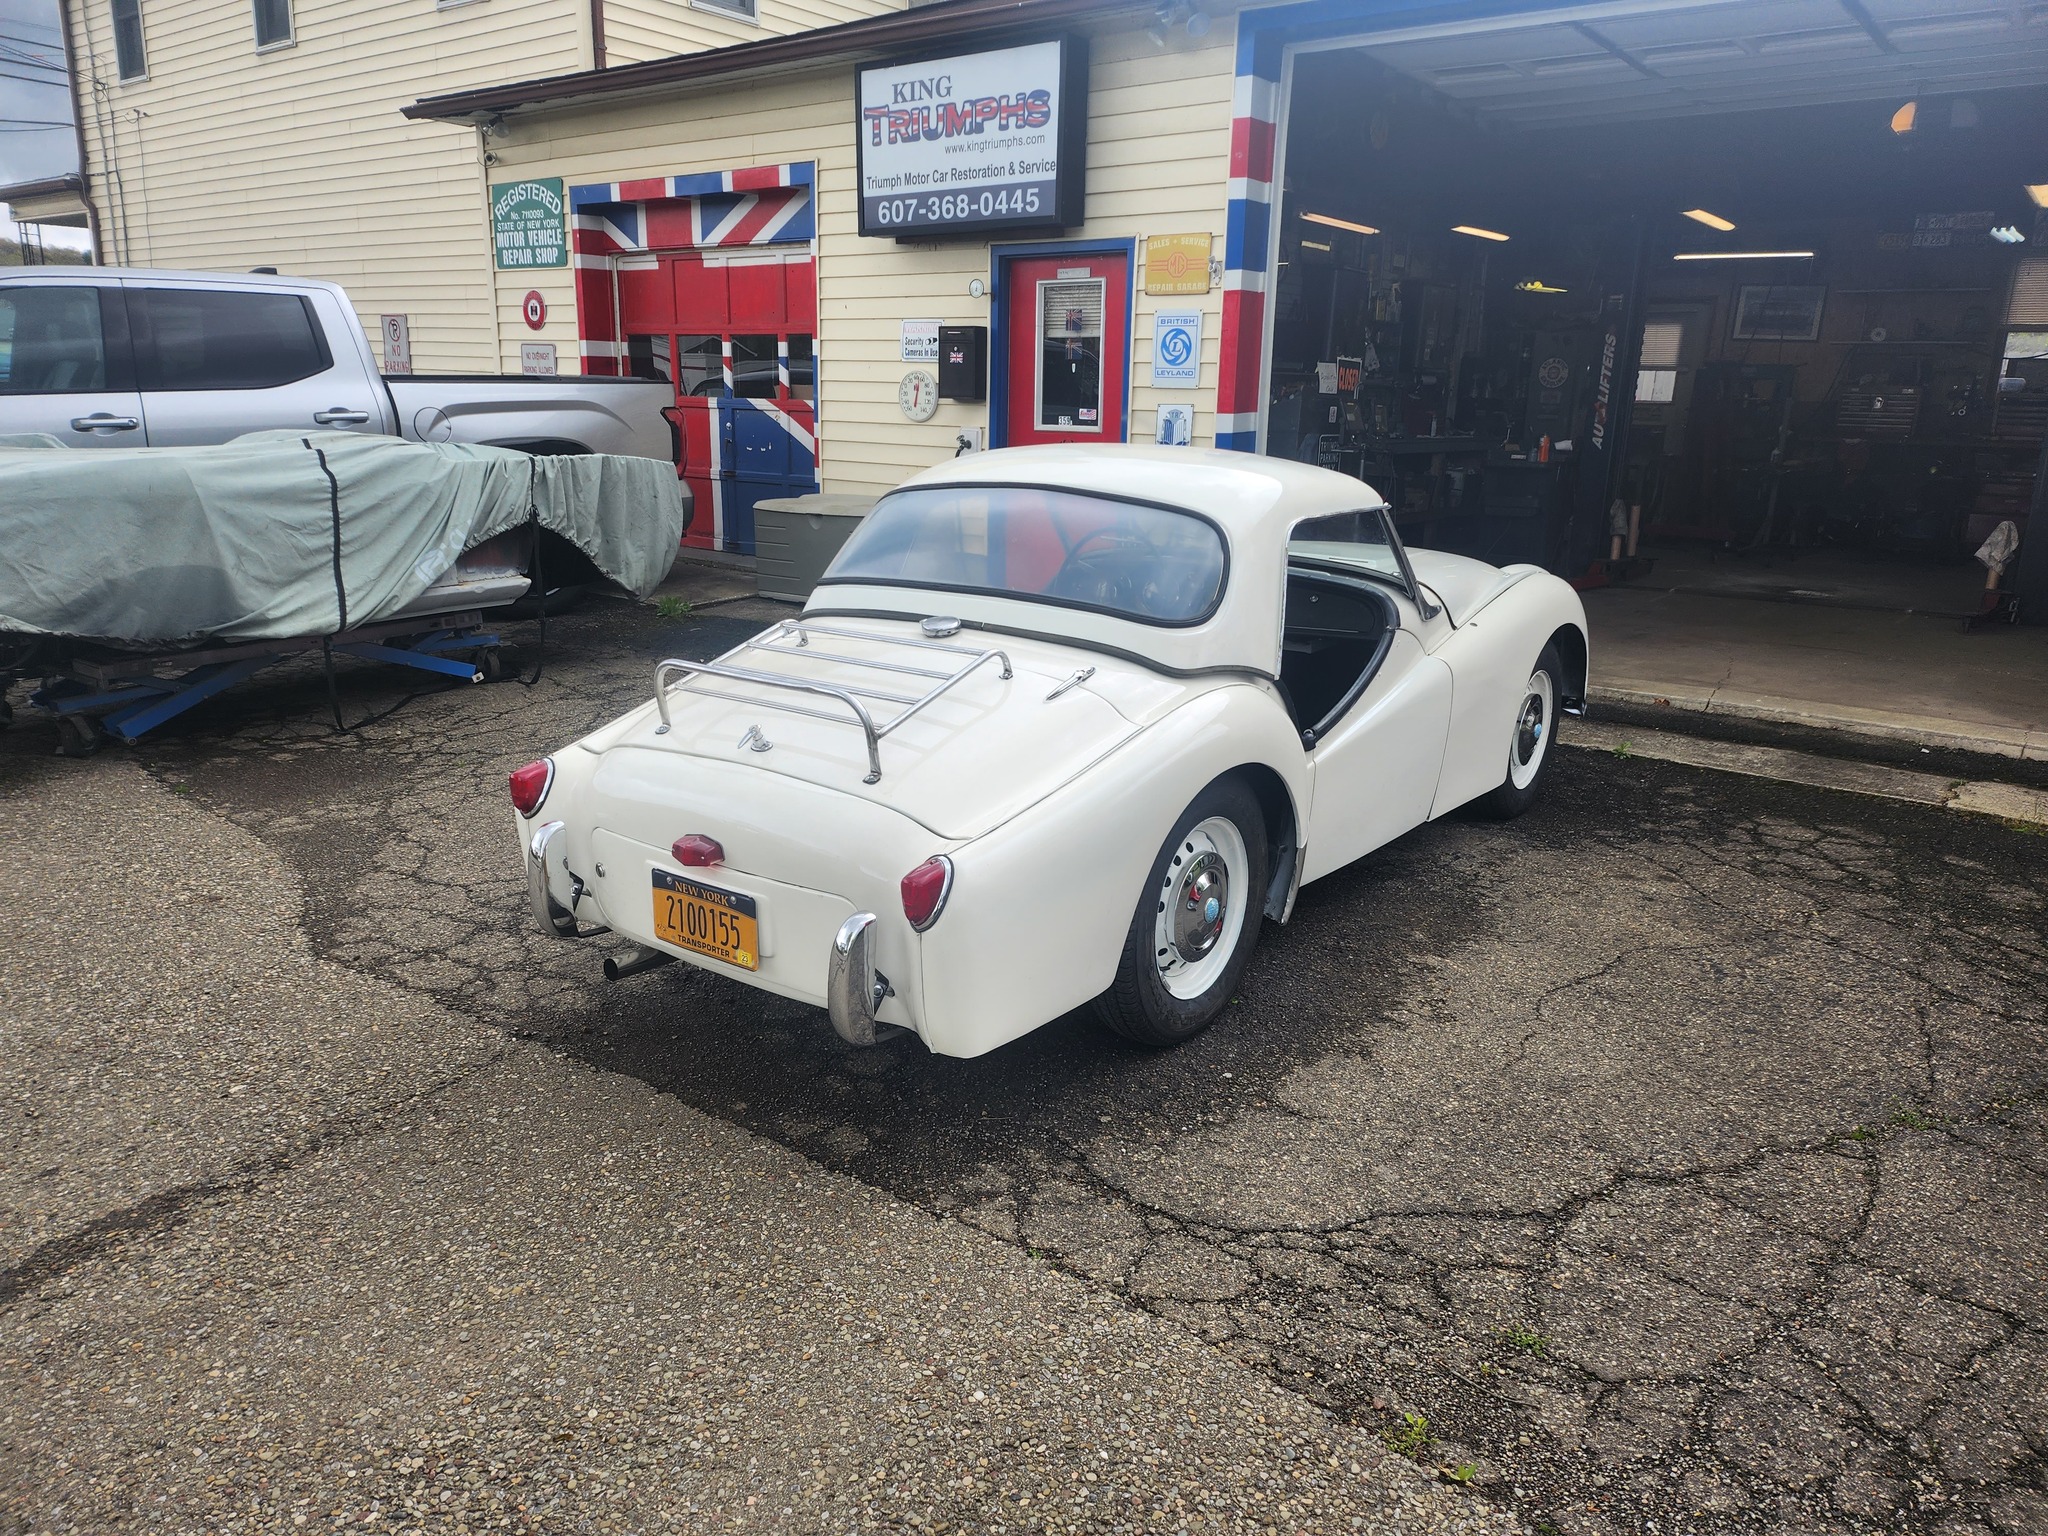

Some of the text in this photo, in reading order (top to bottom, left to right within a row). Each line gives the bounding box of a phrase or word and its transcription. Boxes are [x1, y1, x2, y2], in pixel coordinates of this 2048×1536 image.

[892, 75, 952, 104] KING
[864, 89, 1051, 147] TRIUMPHS
[945, 134, 1045, 155] www.kingtriumphs.com
[867, 158, 1056, 191] Triumph Motor Car Restoration & Service
[494, 183, 561, 221] REGISTERED
[878, 188, 1039, 224] 607-368-0445
[497, 218, 560, 231] STATE OF NEW YORK
[496, 228, 563, 248] MOTOR VEHICLE
[1148, 237, 1209, 250] SALES SERVICE
[502, 247, 558, 265] REPAIR SHOP
[1147, 283, 1173, 292] REPAIR
[904, 323, 937, 333] WARNIN
[391, 345, 401, 357] NO
[905, 336, 924, 347] Security
[905, 347, 923, 357] Cameras
[930, 348, 938, 357] Use
[385, 360, 409, 373] PARKING
[674, 881, 729, 906] NEW YORK
[666, 895, 740, 950] 2100155
[678, 934, 730, 958] TRANSPORTER
